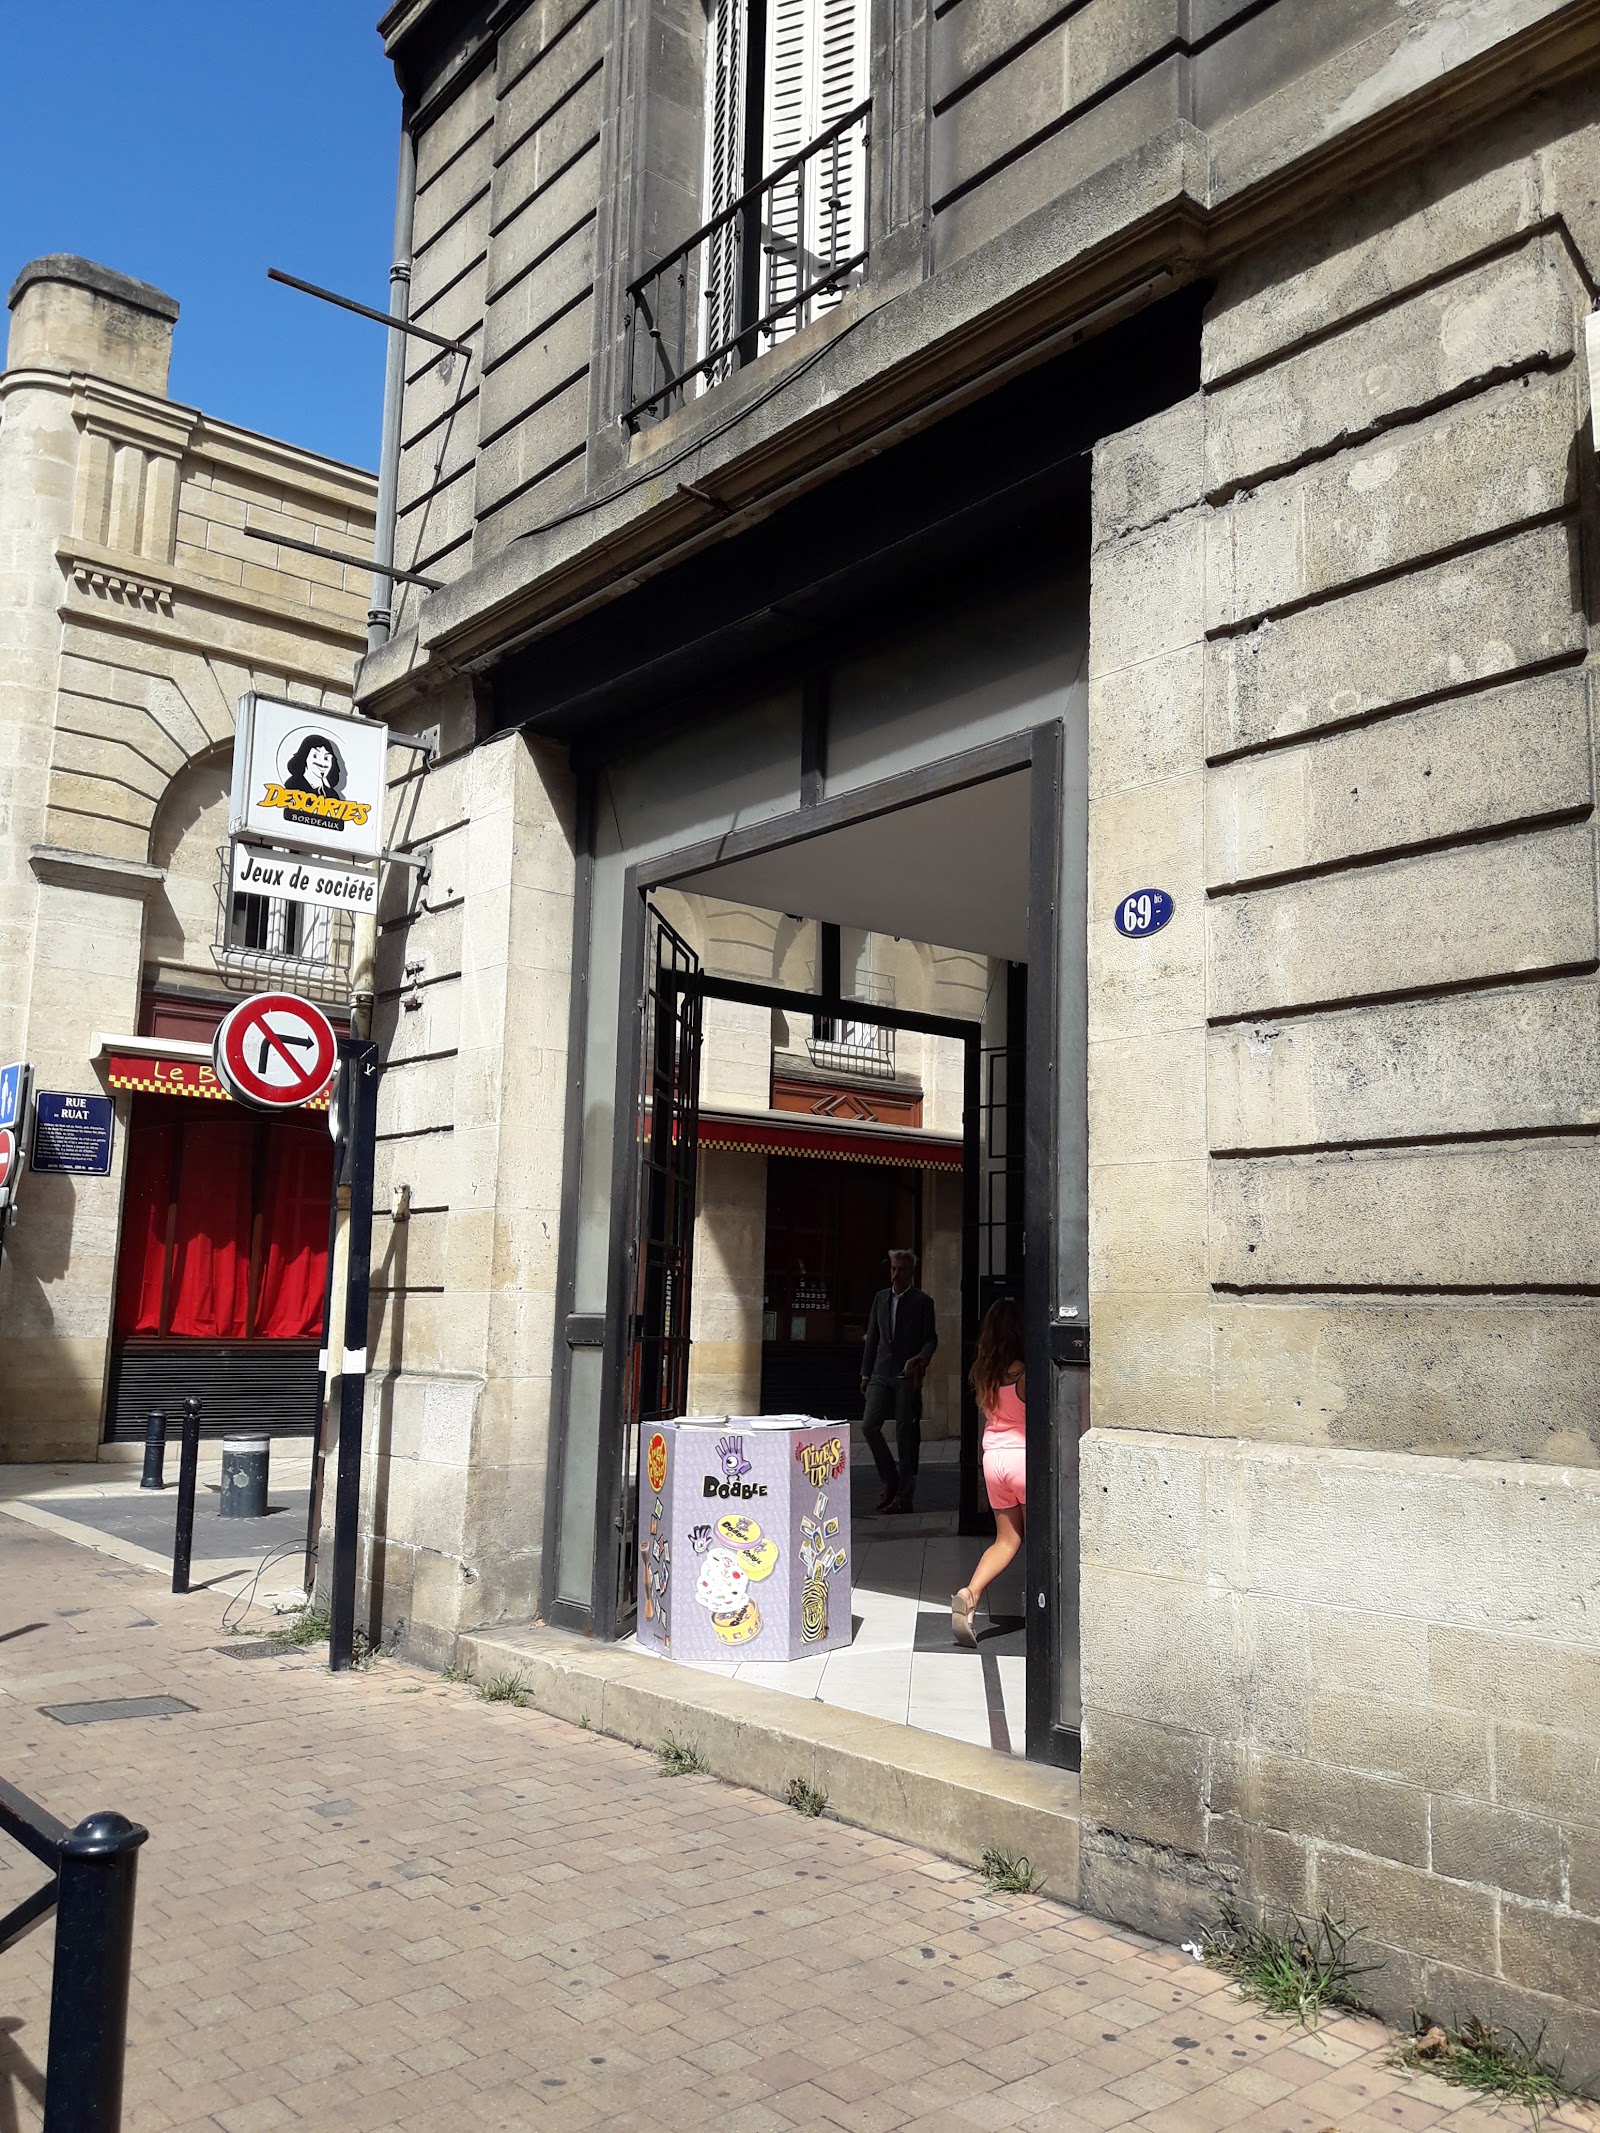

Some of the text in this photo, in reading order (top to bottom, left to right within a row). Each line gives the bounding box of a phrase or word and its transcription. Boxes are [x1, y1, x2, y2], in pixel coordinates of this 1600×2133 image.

[256, 784, 371, 825] DESCARTES
[291, 813, 340, 830] BORDEAUX
[240, 858, 376, 901] Jeux de société
[1123, 894, 1163, 931] 69 bis
[154, 1061, 184, 1081] Le
[61, 1108, 90, 1120] RUAT
[65, 1097, 87, 1108] RUE
[702, 1475, 768, 1499] DOBBLE
[810, 1463, 829, 1488] UP!
